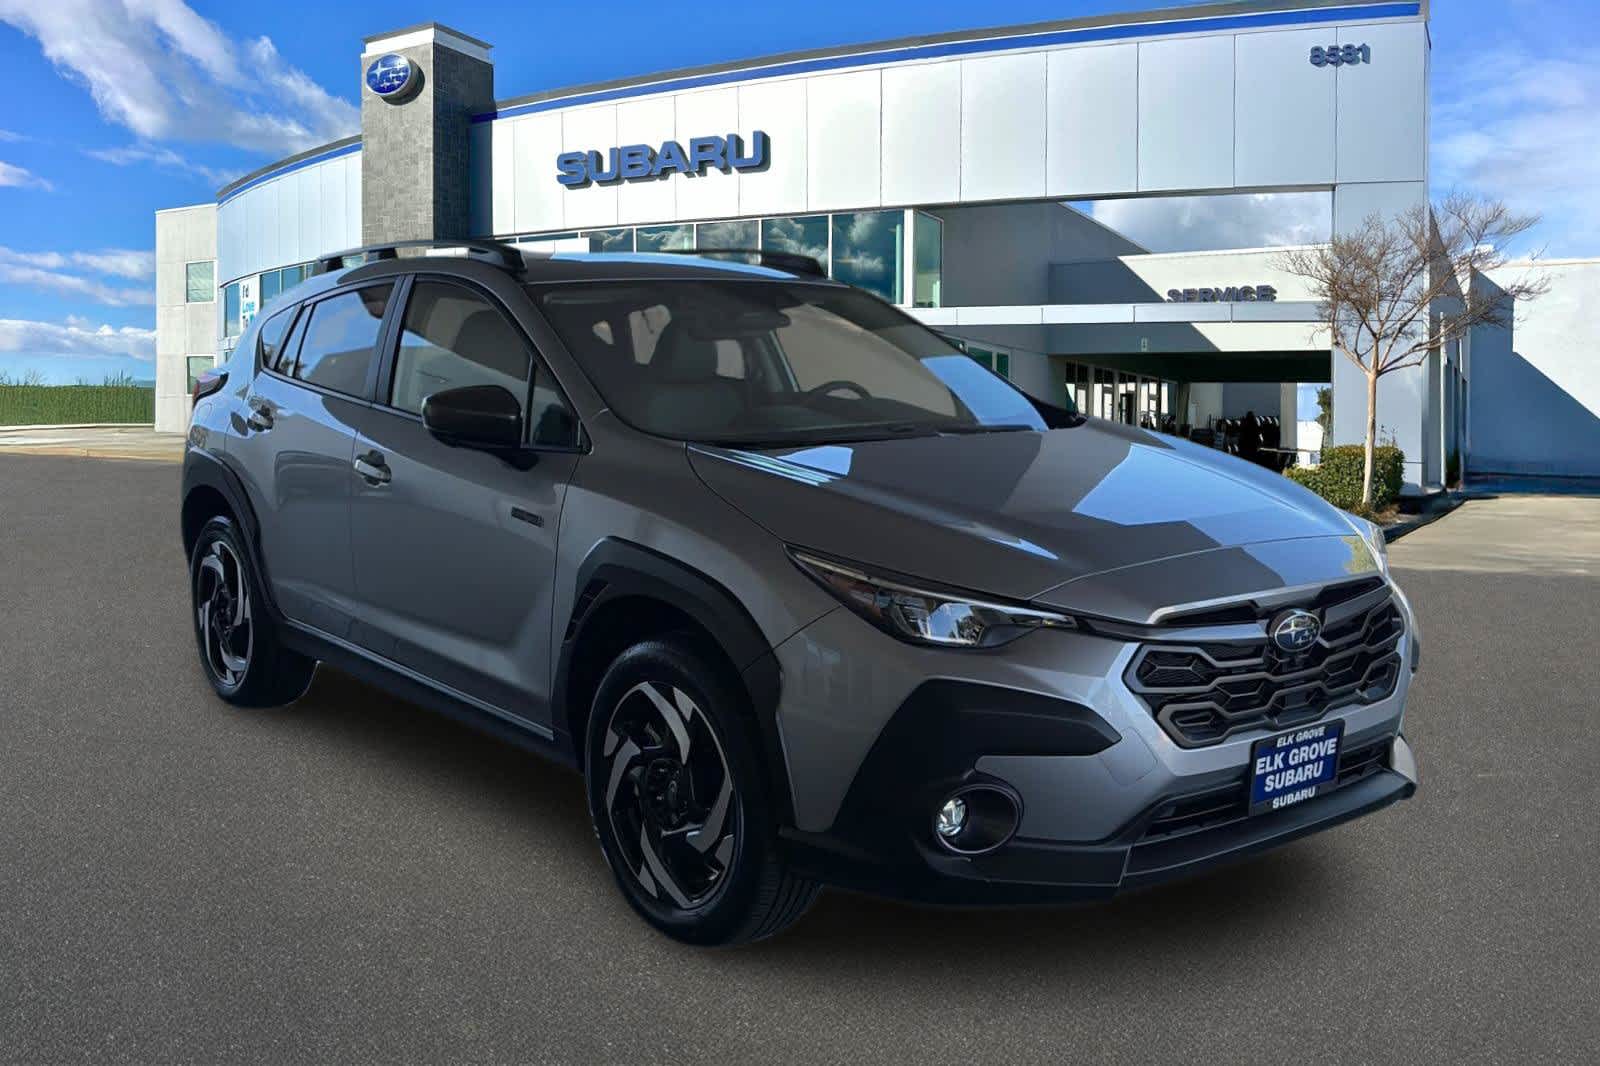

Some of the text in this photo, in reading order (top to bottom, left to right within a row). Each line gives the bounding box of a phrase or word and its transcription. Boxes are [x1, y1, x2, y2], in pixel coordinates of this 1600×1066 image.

[556, 130, 771, 190] SUBARU
[1166, 284, 1277, 302] SERVICE
[1277, 726, 1325, 748] ELK GROVE
[1256, 737, 1337, 775] ELK GROVE
[1264, 760, 1324, 792] SUBARU
[1272, 786, 1316, 809] SUBARU
